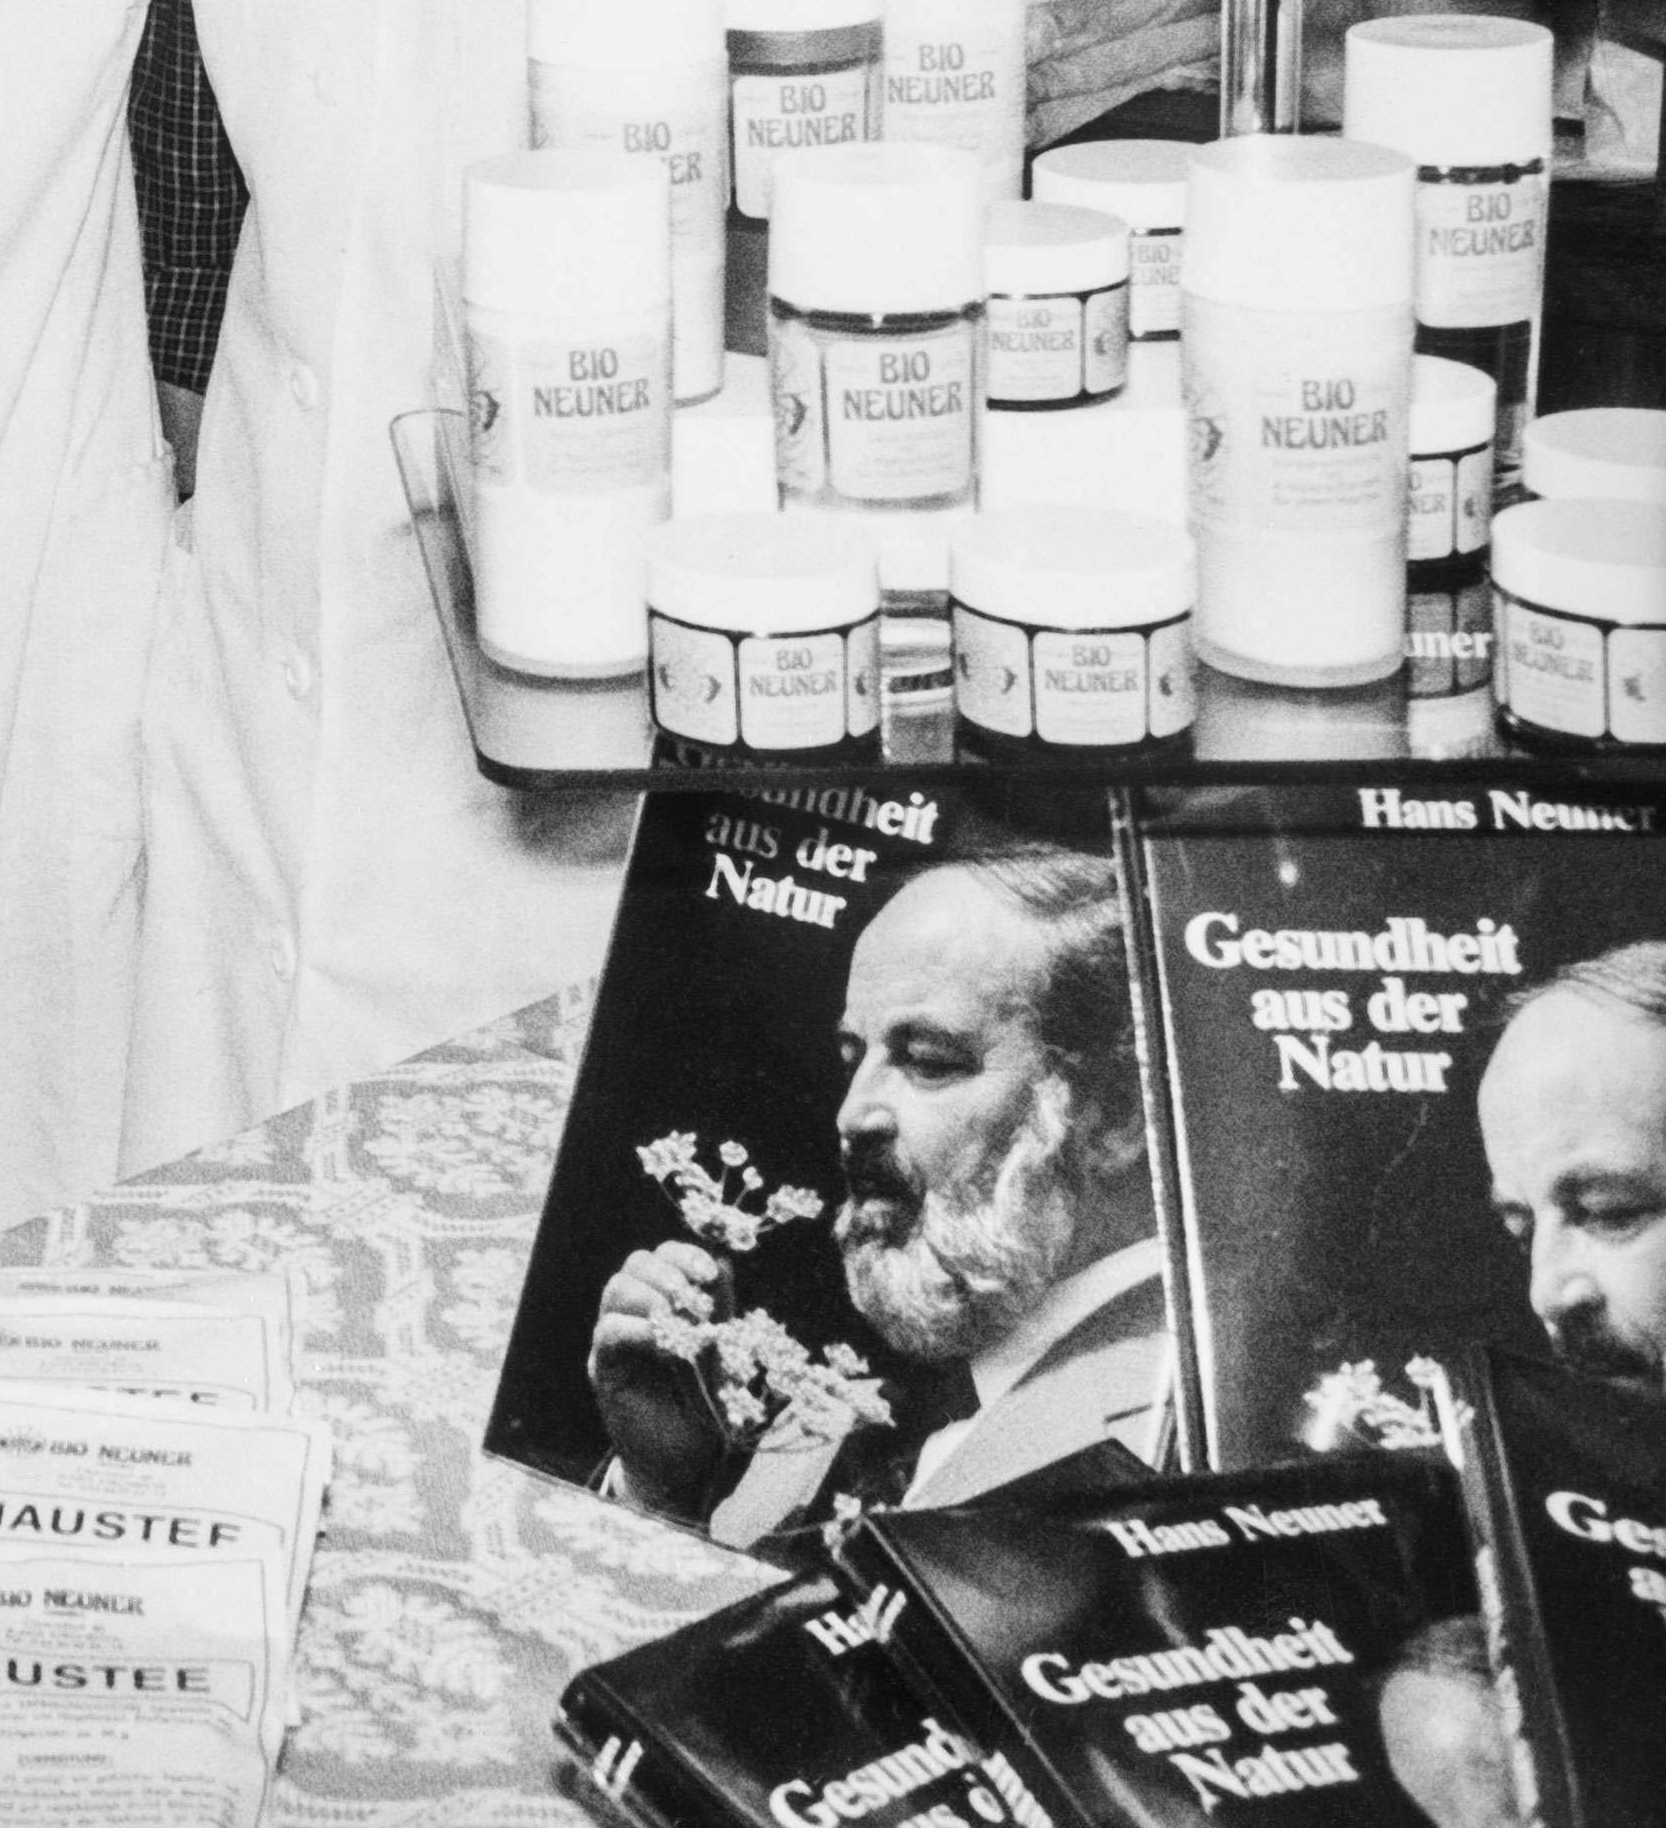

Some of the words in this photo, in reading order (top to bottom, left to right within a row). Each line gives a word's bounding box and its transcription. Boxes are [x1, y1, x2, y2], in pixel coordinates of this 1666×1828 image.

[919, 42, 965, 72] BIO
[779, 83, 827, 115] BIO
[887, 71, 997, 105] NEUNER
[623, 121, 670, 153] BIO
[746, 112, 857, 150] NEUNER
[1466, 192, 1512, 224] BIO
[1137, 243, 1171, 266] BIO
[1428, 219, 1536, 258] NEUNER
[1015, 308, 1053, 330] BIO
[990, 326, 1075, 354] NEUNER
[568, 347, 620, 382] BIO
[878, 350, 931, 386] BIO
[533, 377, 652, 420] NEUNER
[842, 380, 964, 422] NEUNER
[1300, 378, 1356, 413] BIO
[1261, 410, 1390, 451] NEUNER
[1529, 621, 1566, 652] BIO
[775, 648, 813, 672] BIO
[1071, 645, 1113, 667] BIO
[1510, 639, 1595, 684] NEUNER
[749, 671, 838, 699] NEUNER
[1044, 668, 1140, 694] NEUNER
[1358, 787, 1478, 830] Hans
[704, 813, 783, 859] aus
[795, 827, 878, 883] der
[704, 851, 848, 930] Natur
[1183, 910, 1523, 974] Gesundheit
[1251, 983, 1352, 1033] aus
[1368, 976, 1468, 1034] der
[1276, 1033, 1453, 1093] Natur
[98, 1443, 193, 1468] NEUNER
[1107, 1513, 1231, 1559] Hans
[1223, 1497, 1389, 1542] Neuner
[43, 1586, 146, 1616] NEUNER
[1021, 1616, 1355, 1705] Gesundheit
[1123, 1700, 1233, 1755] aus
[1235, 1681, 1339, 1737] der
[1168, 1740, 1361, 1816] Natur
